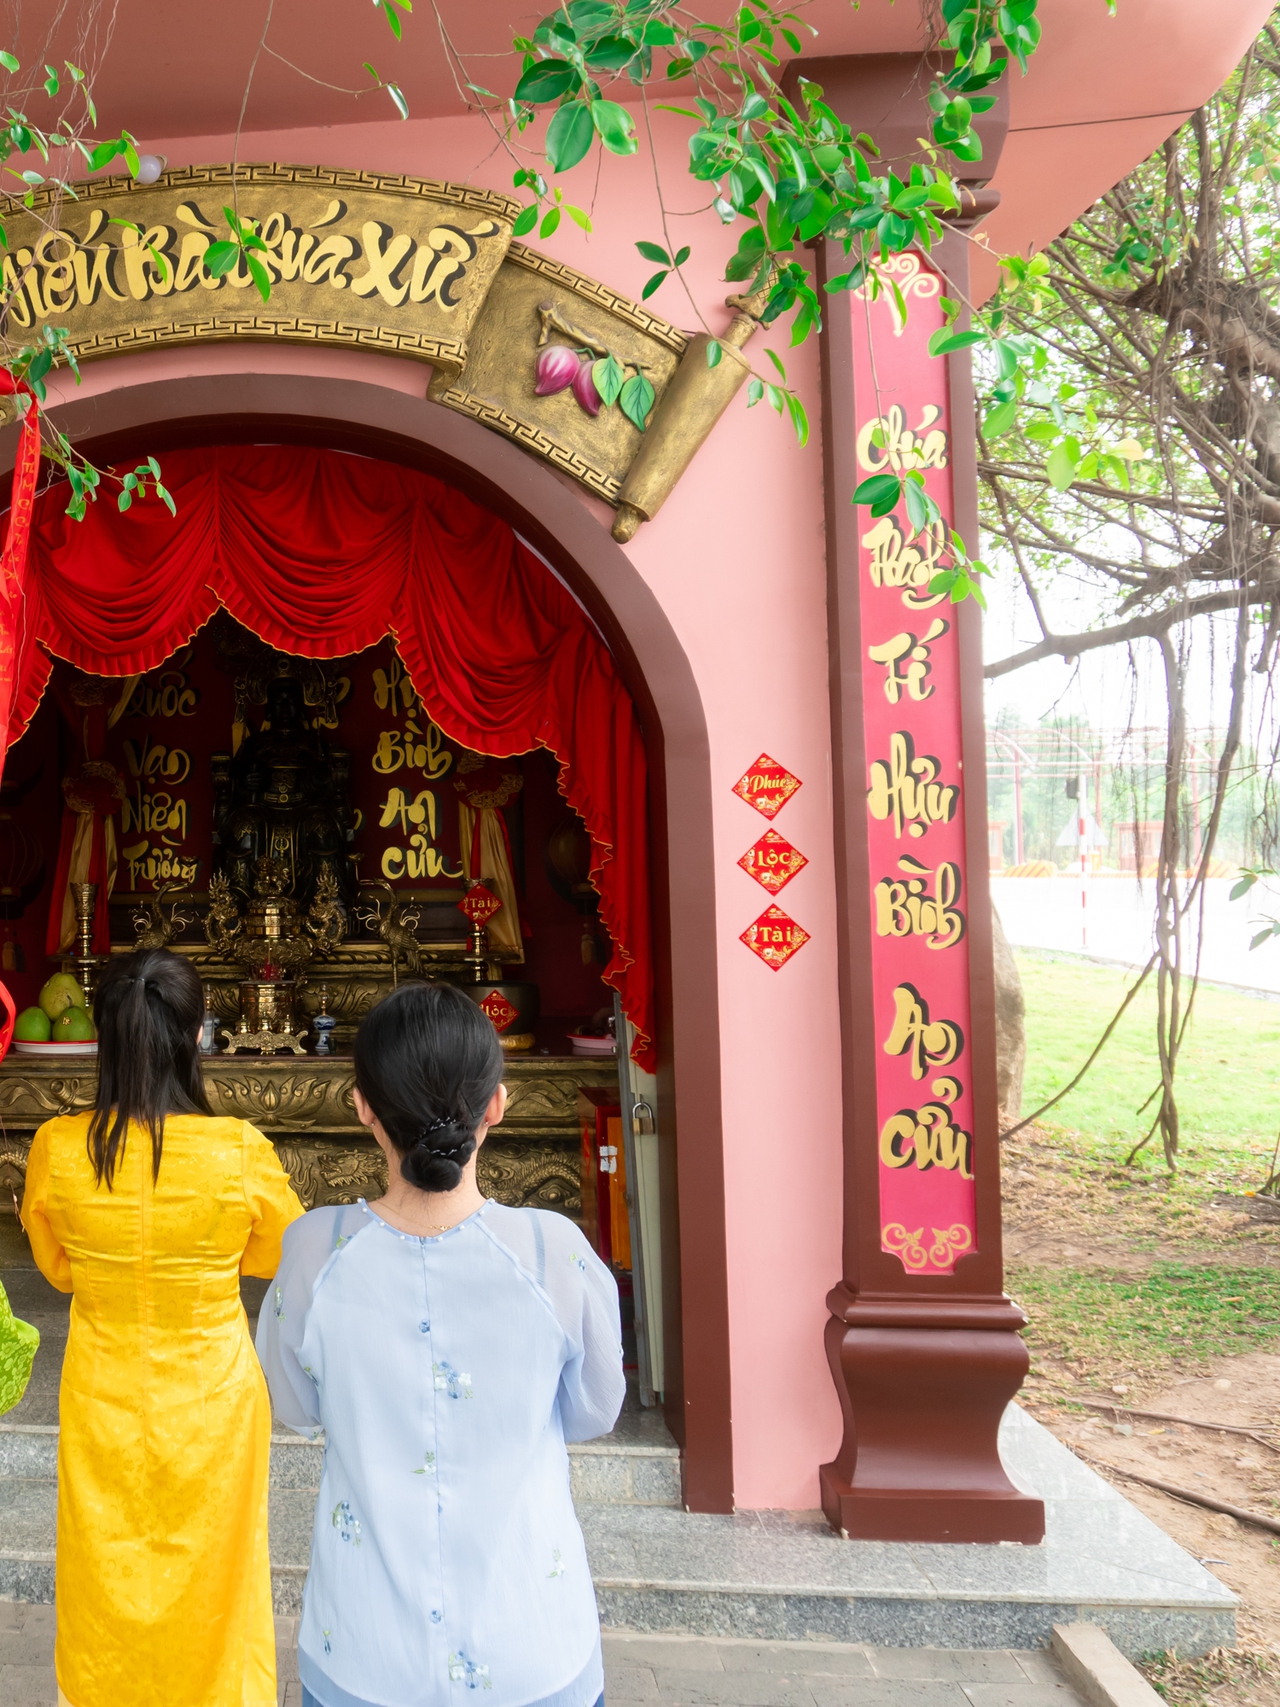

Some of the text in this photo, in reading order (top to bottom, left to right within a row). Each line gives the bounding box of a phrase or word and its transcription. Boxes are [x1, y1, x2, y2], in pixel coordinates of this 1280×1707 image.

[122, 204, 220, 301] Bà
[228, 200, 348, 289] Chúa
[351, 220, 493, 313] Xứ
[857, 404, 948, 472] Chúa
[869, 618, 945, 704] Tí
[121, 780, 187, 841] Niên
[379, 787, 437, 841] An
[749, 774, 787, 793] Phúc
[868, 733, 954, 839] Hựu
[381, 823, 465, 880] Cửu
[757, 849, 790, 868] Lộc
[470, 896, 491, 909] Tài
[760, 925, 792, 942] Tài
[884, 987, 958, 1080] An
[880, 1077, 974, 1180] Cửu
